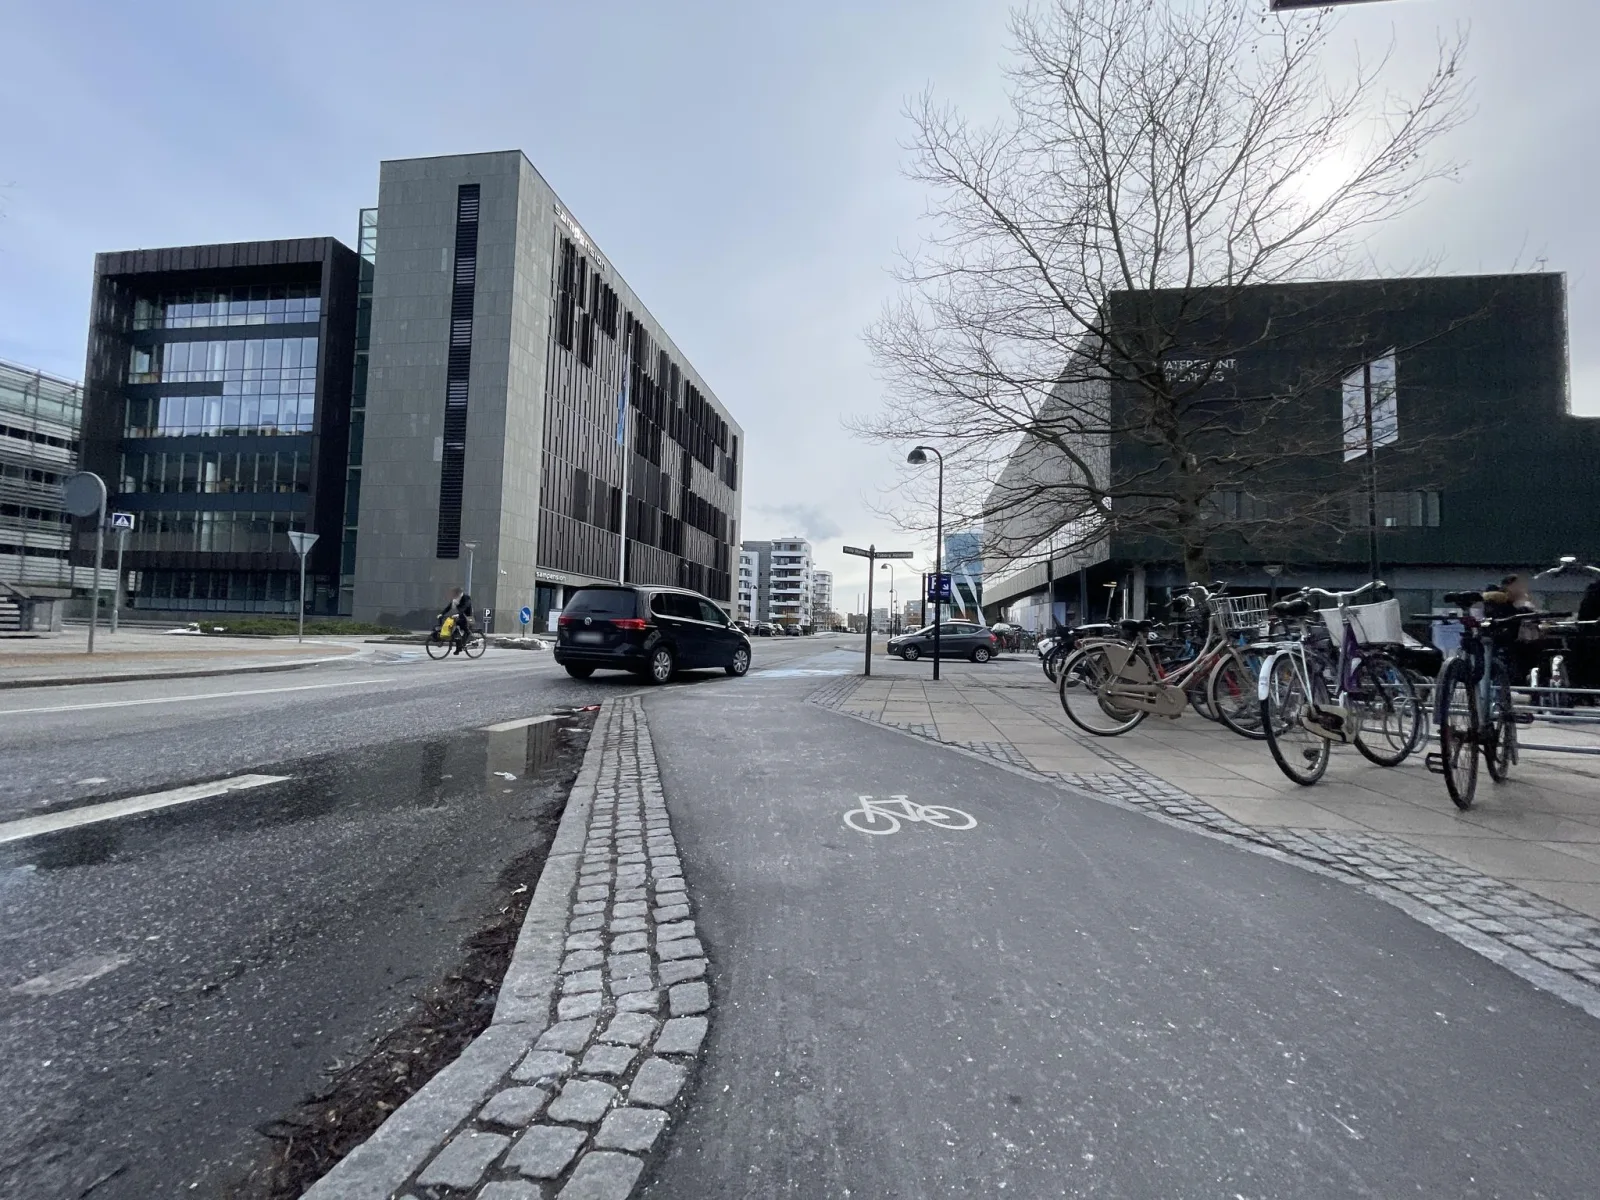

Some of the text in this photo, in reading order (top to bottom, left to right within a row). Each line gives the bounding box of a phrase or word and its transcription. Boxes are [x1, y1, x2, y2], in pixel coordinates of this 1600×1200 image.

[555, 203, 606, 272] sampension
[1154, 358, 1236, 370] ATERFRNT
[485, 609, 491, 617] P
